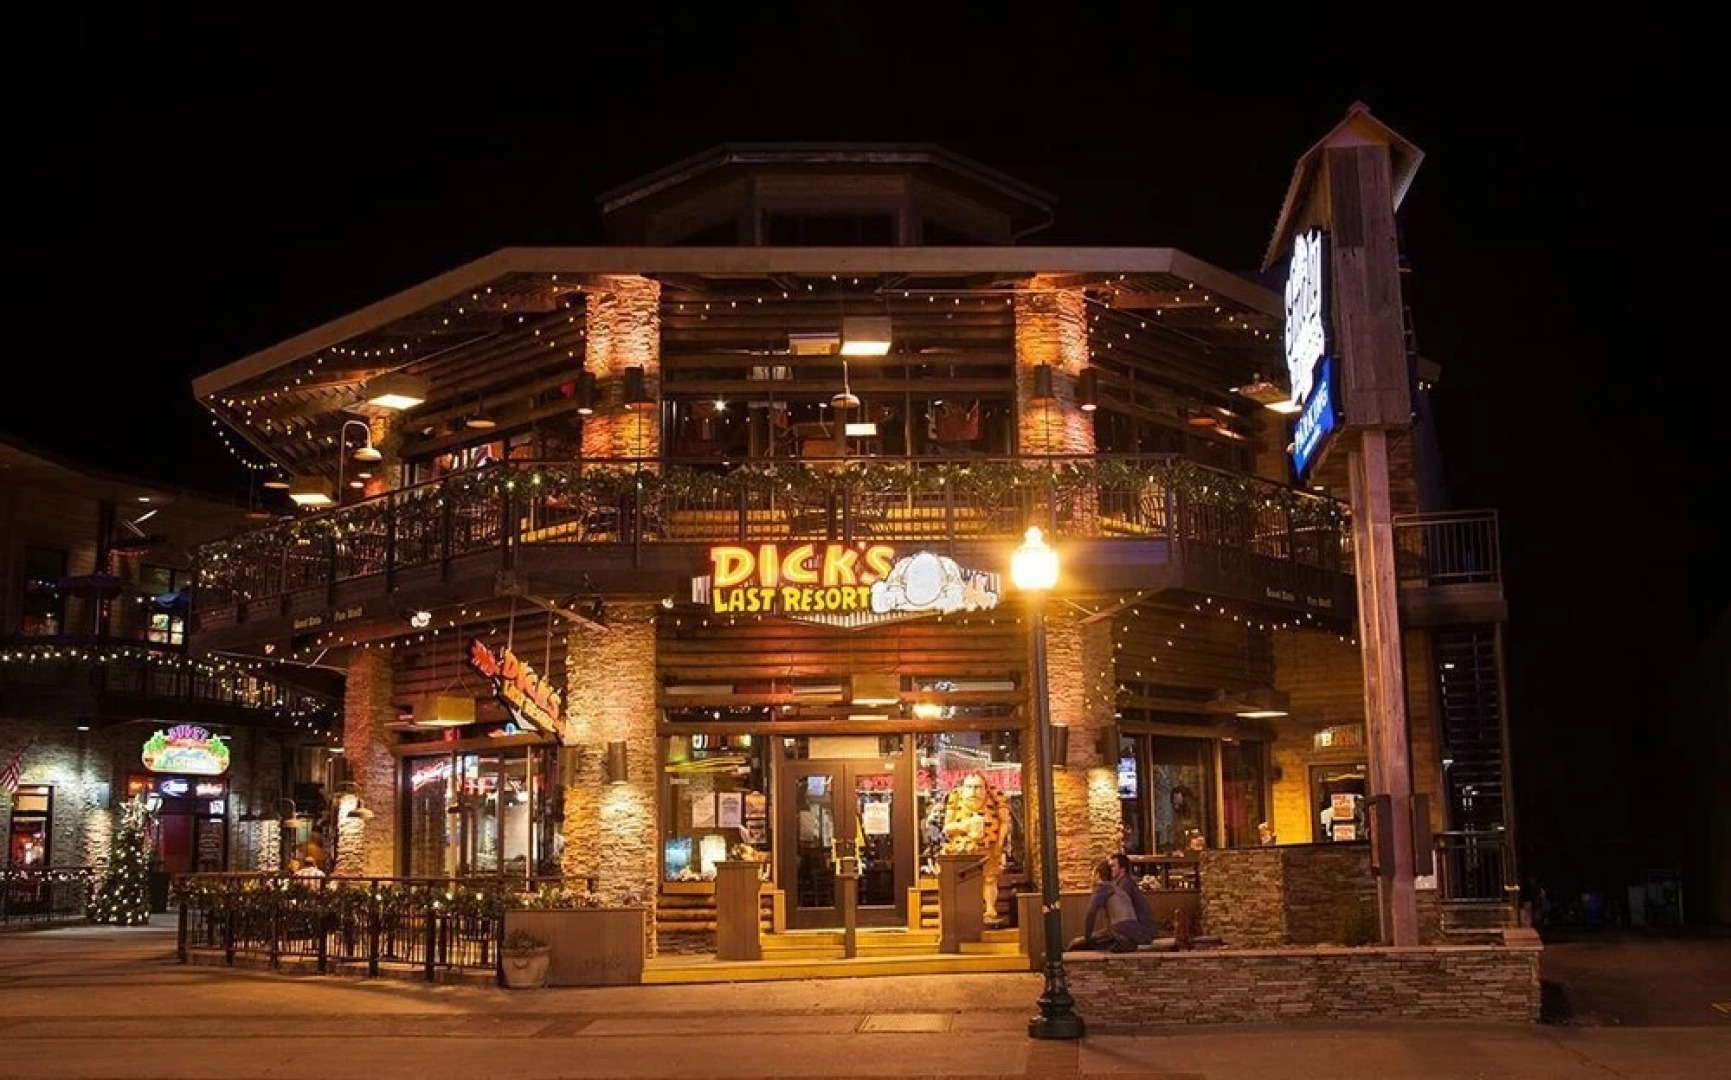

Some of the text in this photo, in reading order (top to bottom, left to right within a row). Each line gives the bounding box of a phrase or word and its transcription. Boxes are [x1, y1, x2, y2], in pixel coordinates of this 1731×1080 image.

[711, 542, 896, 587] DICK'S
[713, 585, 871, 613] LAST RESORT
